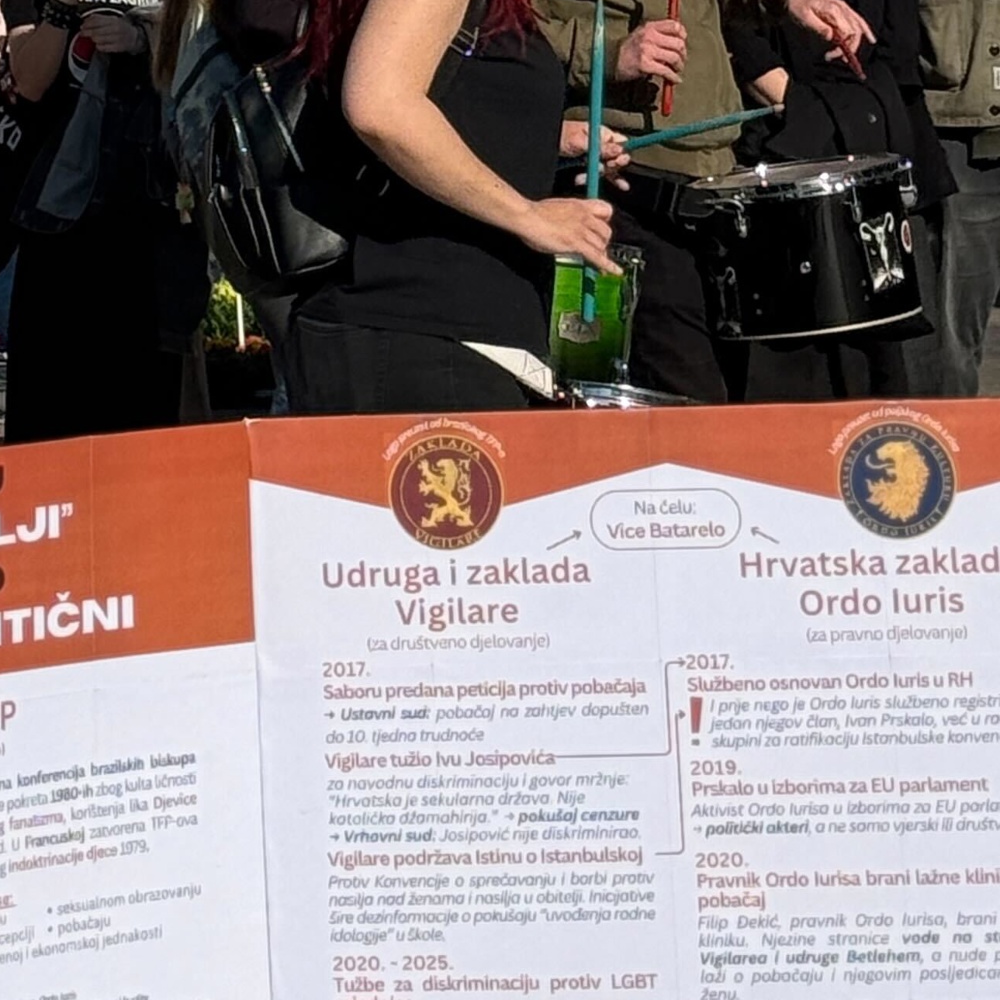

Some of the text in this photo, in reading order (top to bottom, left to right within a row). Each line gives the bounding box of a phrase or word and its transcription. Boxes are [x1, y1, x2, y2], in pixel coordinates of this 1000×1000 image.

[634, 499, 697, 515] Na čelu:
[606, 522, 726, 539] Vice Batarelo
[739, 549, 887, 578] Hrvatska
[322, 556, 591, 594] Udruga i zaklada
[800, 586, 964, 616] Ordo Iuris
[395, 598, 519, 632] Vigilare
[367, 632, 550, 652] (za društveno djelovanje)
[806, 625, 968, 644] (za pravno djelovanje)
[322, 662, 371, 678] 2017.
[686, 654, 734, 670] 2017.
[323, 678, 646, 702] Saboru predana peticija protiv pobačaja
[687, 672, 973, 693] Službeno osnovan Ordo Iuris u RH
[341, 706, 395, 721] Ustavni
[436, 703, 494, 723] pobačaj
[581, 702, 649, 721] dopušten
[881, 713, 937, 728] Prskalo,
[325, 730, 345, 744] do
[372, 728, 416, 746] tjedna
[419, 727, 485, 743] trudnoće
[17, 765, 85, 788] konferencija
[150, 753, 196, 770] biskupa
[324, 750, 556, 772] Vigilare tužio Ivu Josipovića
[690, 760, 742, 776] 2019.
[417, 773, 519, 791] diskriminaciju
[692, 777, 989, 797] Prskalo u izborima za EU parlament
[439, 828, 510, 844] Josipović
[327, 847, 643, 870] Vigilare podržava Istinu o Istanbulskoj
[695, 852, 749, 868] 2020.
[697, 872, 761, 889] Pravnik
[765, 871, 810, 888] Ordo
[815, 869, 861, 887] Iurisa
[866, 868, 911, 885] brani
[915, 868, 961, 885] lažne
[128, 883, 201, 905] obrazovanju
[698, 892, 766, 913] pobačaj
[790, 912, 847, 930] pravnik
[855, 913, 894, 928] Ordo
[957, 911, 997, 926] brani
[102, 924, 163, 949] jednakosti
[332, 956, 386, 972] 2020.
[402, 955, 454, 971] 2025.
[333, 973, 657, 996] Tužbe za diskriminaciju protiv LGBT
